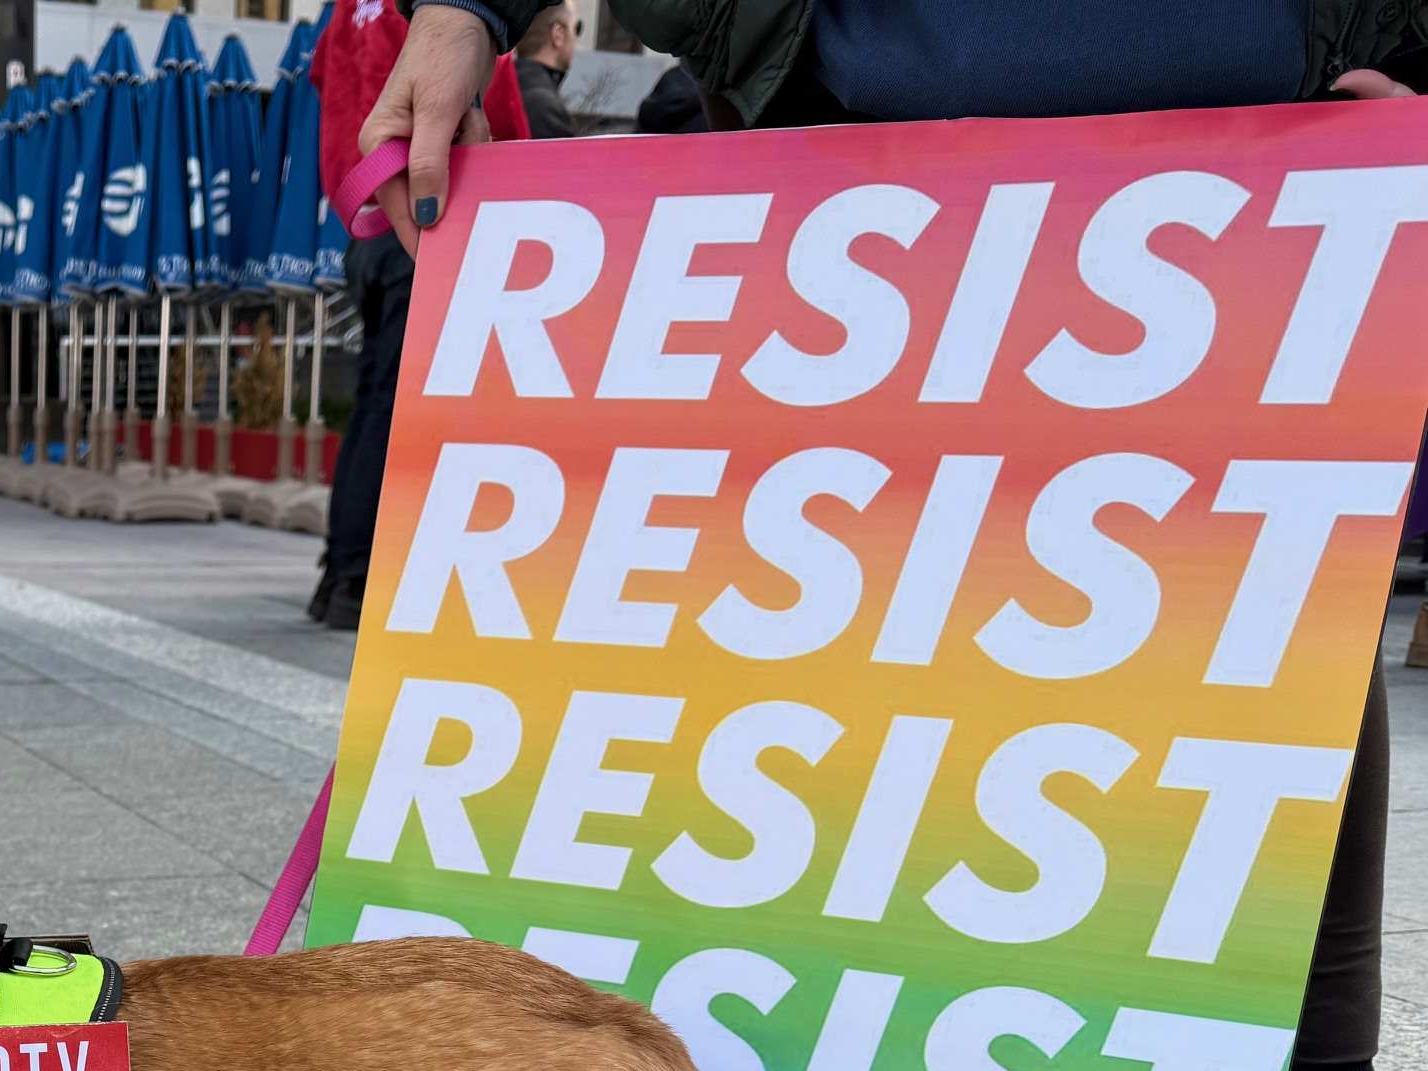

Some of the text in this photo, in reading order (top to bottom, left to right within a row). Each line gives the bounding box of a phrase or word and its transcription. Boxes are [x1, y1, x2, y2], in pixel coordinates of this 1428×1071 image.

[422, 165, 1428, 409] RESIST
[386, 442, 1413, 687] RESIST
[346, 678, 1353, 963] RESIST
